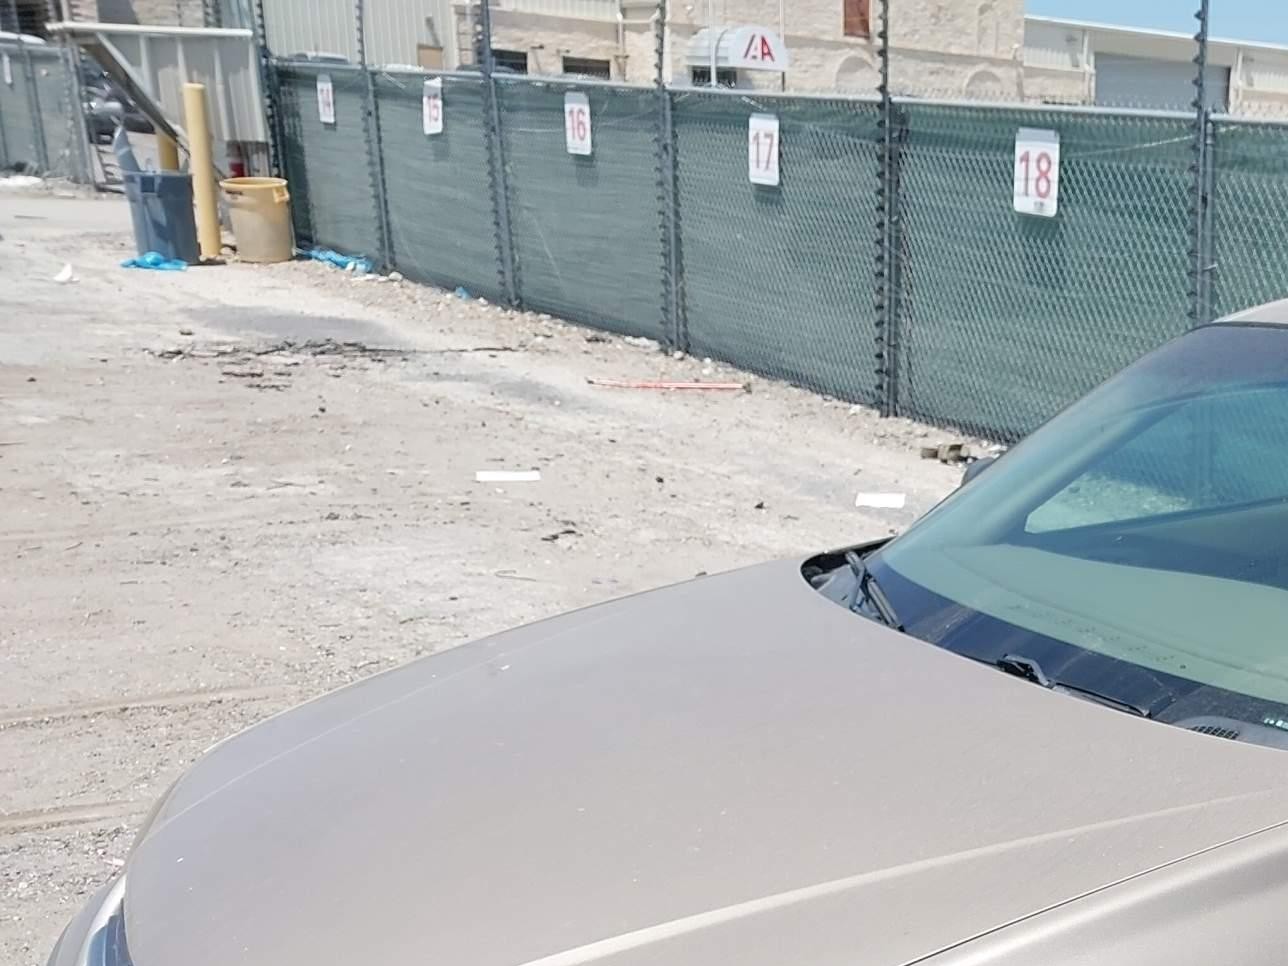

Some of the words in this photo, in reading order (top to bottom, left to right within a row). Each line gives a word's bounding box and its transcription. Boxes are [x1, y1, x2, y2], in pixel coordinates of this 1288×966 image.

[568, 107, 587, 142] 16
[752, 131, 774, 172] 17
[1019, 150, 1052, 199] 18
